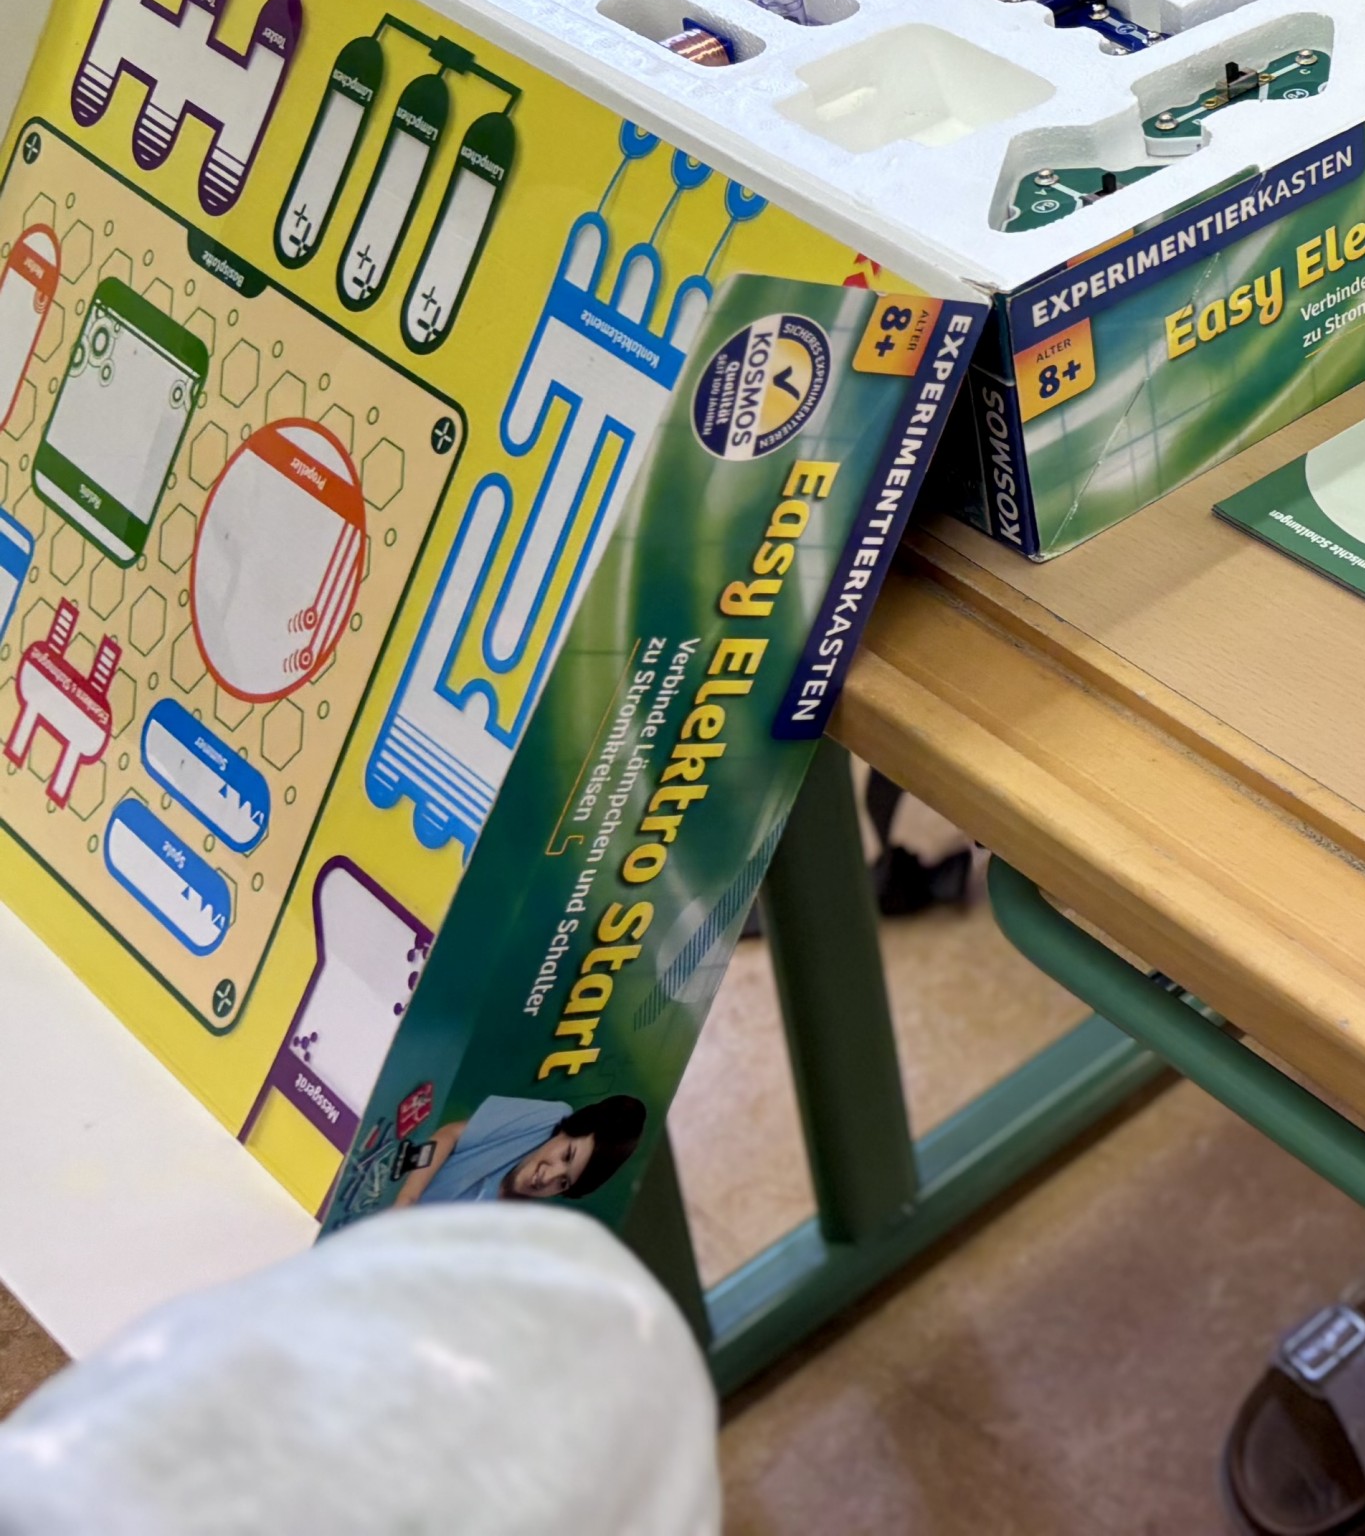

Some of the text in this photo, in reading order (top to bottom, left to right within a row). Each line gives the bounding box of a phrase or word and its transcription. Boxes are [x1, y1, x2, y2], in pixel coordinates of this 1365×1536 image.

[261, 26, 286, 50] Taster
[331, 68, 373, 102] Lämpchen
[395, 105, 439, 141] Lämpchen
[459, 144, 505, 181] Lämpchen
[1031, 146, 1352, 326] EXPERIMENTIERKASTEN
[201, 249, 245, 288] Basisplatte
[579, 309, 660, 368] Kontaktelemente
[874, 304, 912, 357] 8+
[905, 308, 930, 351] ALTER
[1161, 268, 1284, 358] Easy
[1301, 326, 1322, 348] zu
[1035, 337, 1071, 363] ALTER
[715, 360, 740, 424] Qualität
[730, 331, 772, 447] KOSMOS
[1037, 359, 1081, 399] 8+
[289, 456, 327, 490] Propeller
[983, 386, 1022, 545] KOSMOS
[793, 314, 971, 720] EXPERIMENTIERKASTEN
[1268, 509, 1333, 548] Schaltungen
[573, 636, 667, 821] zu Stromkreisen
[538, 459, 838, 1078] Easy Elektro Start
[523, 637, 701, 1016] Verbinde Lämpchen und Schalter
[294, 1072, 340, 1124] Messgerät
